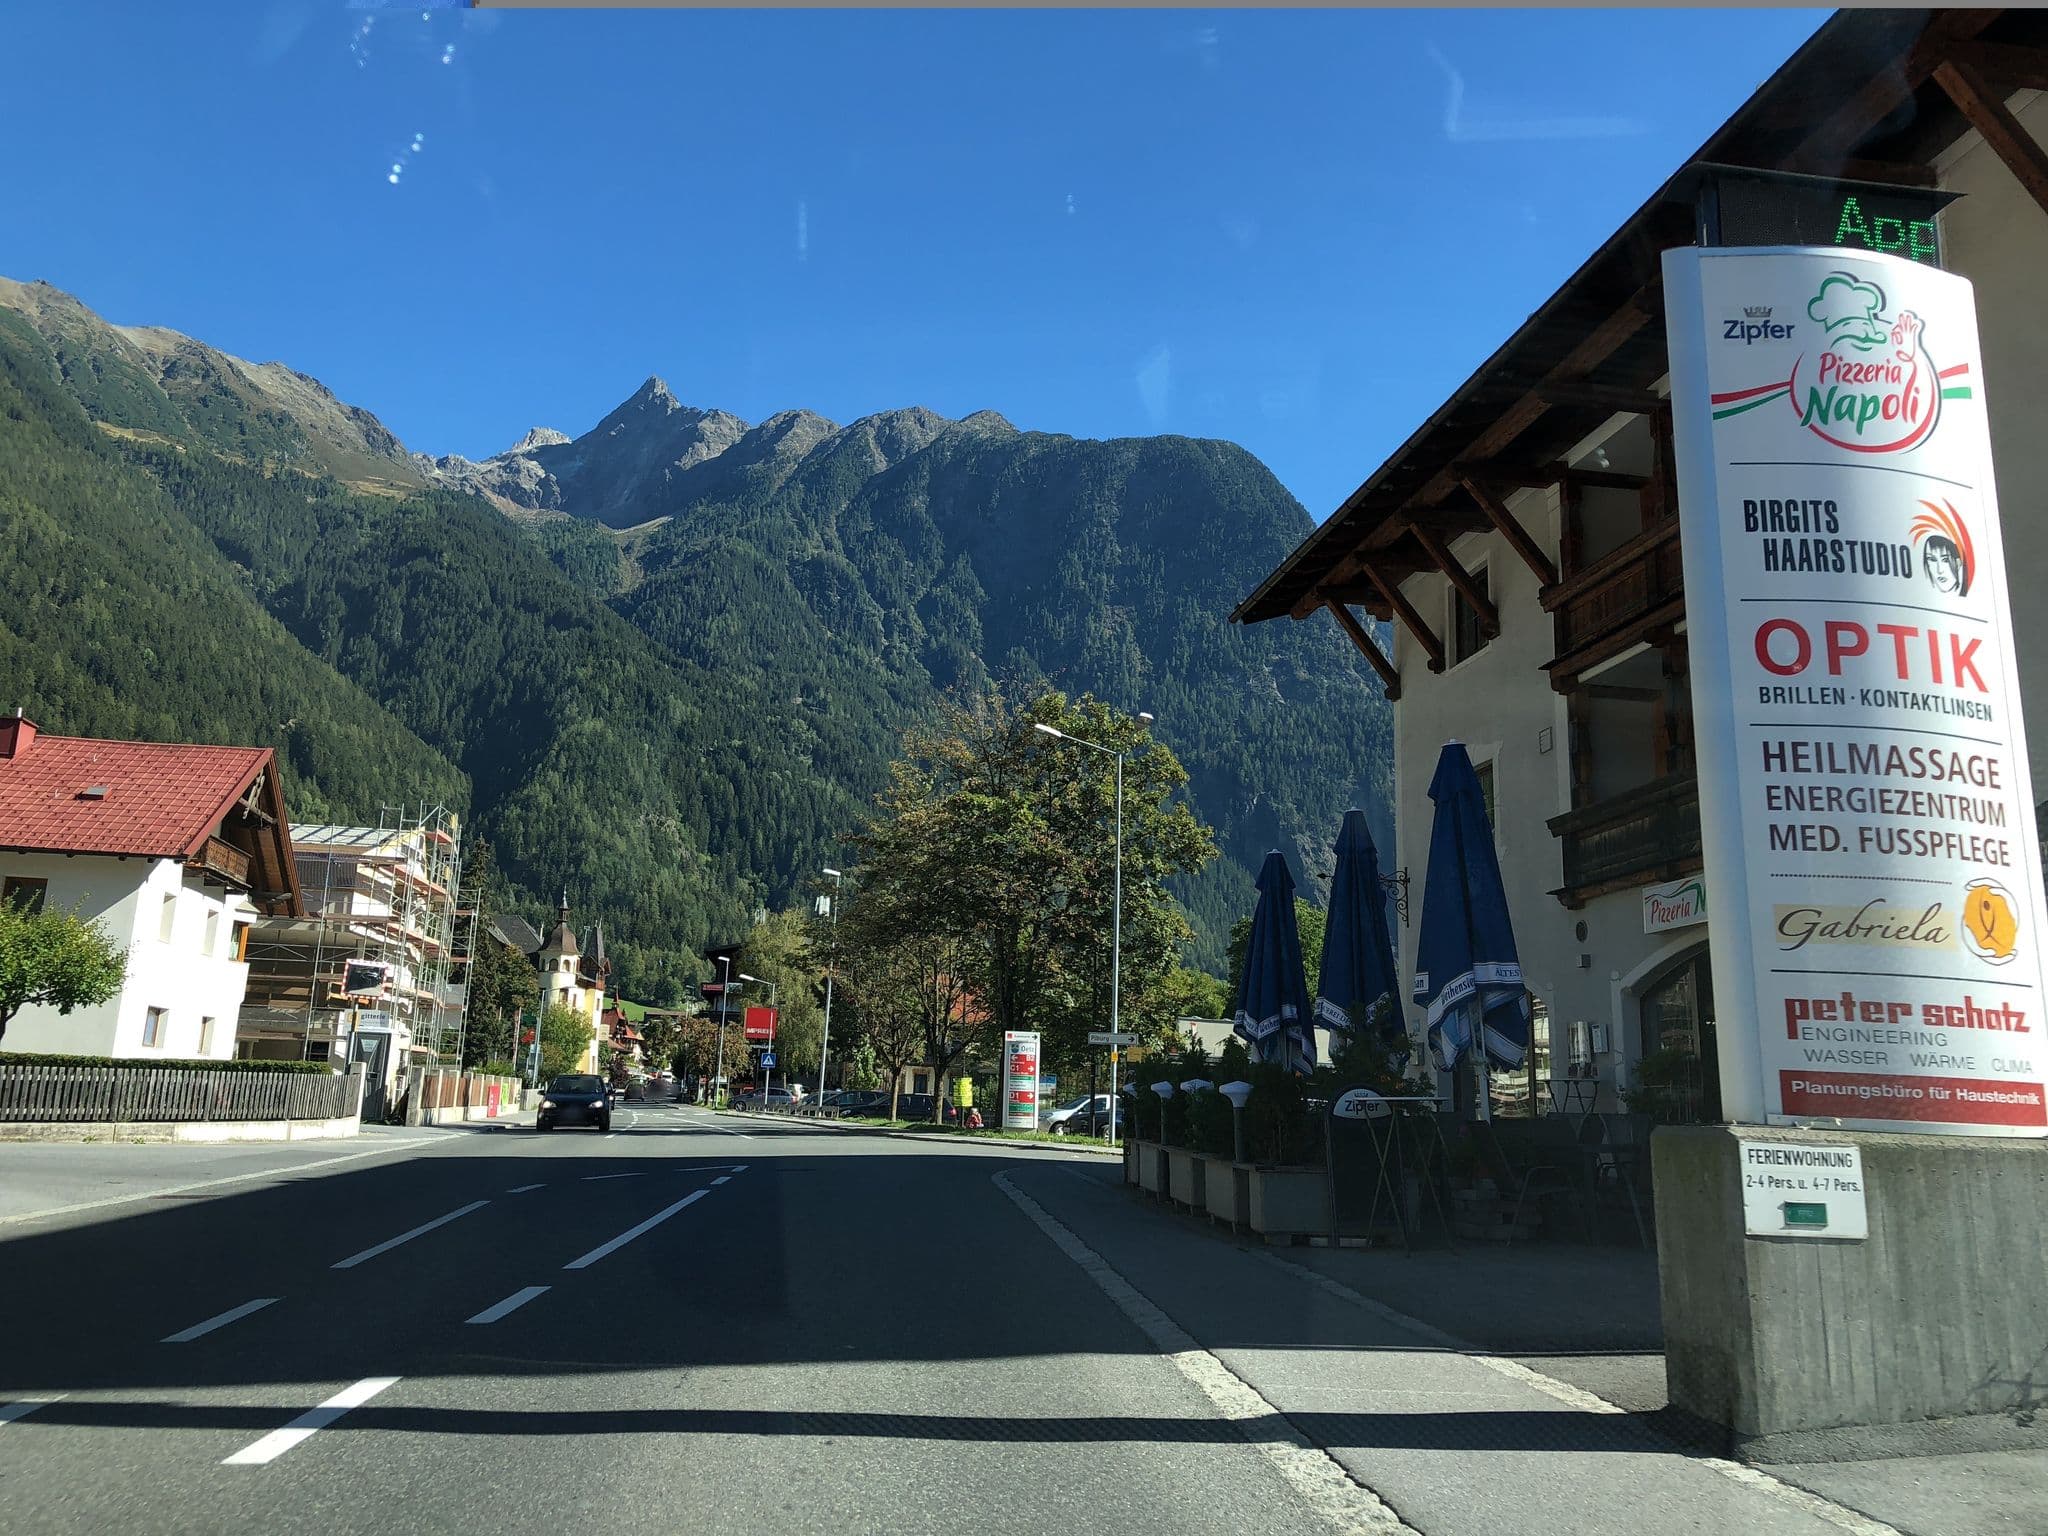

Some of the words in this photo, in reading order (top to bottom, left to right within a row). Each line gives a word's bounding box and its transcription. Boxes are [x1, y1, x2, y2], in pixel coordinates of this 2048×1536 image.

[1723, 319, 1795, 345] Zipfer
[1818, 352, 1902, 385] Pizzeria
[1801, 385, 1920, 435] Napoli
[1743, 499, 1840, 534] BIRGITS
[1763, 538, 1913, 580] HAARSTUDIO
[1754, 618, 1989, 694] OPTIK
[1759, 686, 1846, 705] BRILLEN
[1860, 688, 1993, 723] KONTAKTLINSEN
[1762, 740, 2001, 790] HEILMASSAGE
[1766, 785, 2007, 828] ENERGIEZENTRUM
[1769, 824, 1848, 852] MED.
[1858, 826, 2011, 868] FUSSPFLEGE
[1651, 897, 1690, 925] Pizzeria
[1778, 898, 1951, 951] Gabriela
[1784, 992, 1912, 1040] peter
[1922, 995, 2031, 1033] schatz
[1801, 1027, 1948, 1047] ENGINEERING
[1803, 1048, 1889, 1065] WASSER
[1910, 1051, 1977, 1070] WÄRME
[1991, 1058, 2034, 1074] CLIMA
[1791, 1080, 1923, 1099] Planungsbüro
[1929, 1086, 1951, 1100] für
[1956, 1088, 2041, 1106] Haustechnik
[1747, 1148, 1853, 1168] FERIENWOHNUNG
[1746, 1174, 1764, 1188] 2-4
[1768, 1175, 1796, 1189] Pers.
[1798, 1179, 1808, 1190] u.
[1813, 1177, 1830, 1191] 4-7
[1834, 1178, 1861, 1192] Pers.
